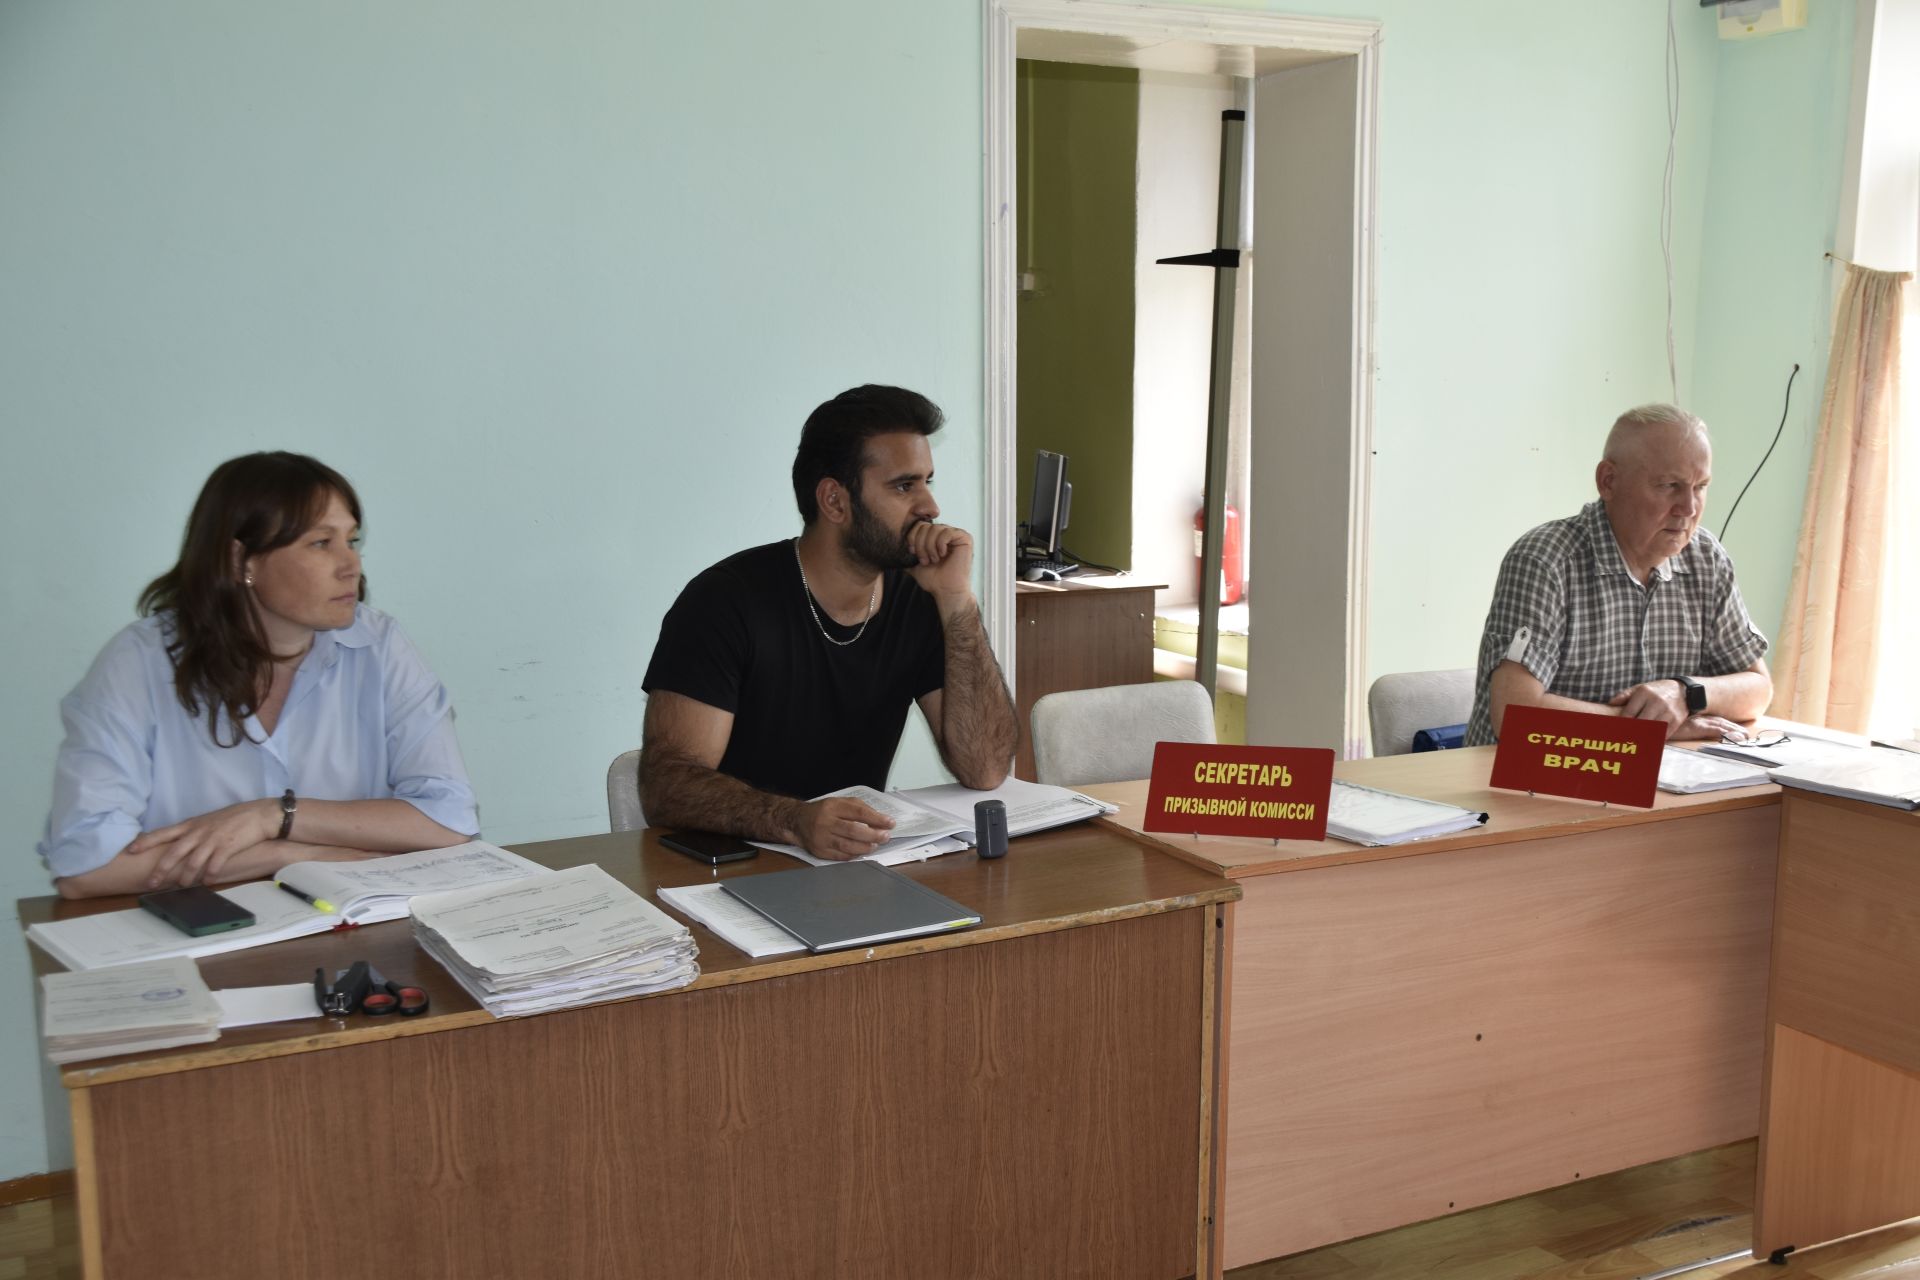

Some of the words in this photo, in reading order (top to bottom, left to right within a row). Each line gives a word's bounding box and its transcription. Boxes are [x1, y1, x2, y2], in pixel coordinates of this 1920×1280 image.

[1527, 733, 1637, 755] СТАРШИЙ
[1194, 761, 1293, 787] СЕКРЕТАРЬ
[1543, 753, 1621, 775] ВРАЧ
[1164, 796, 1247, 817] ПРИЗЫВНОЙ
[1249, 800, 1315, 821] КОМИССИ
